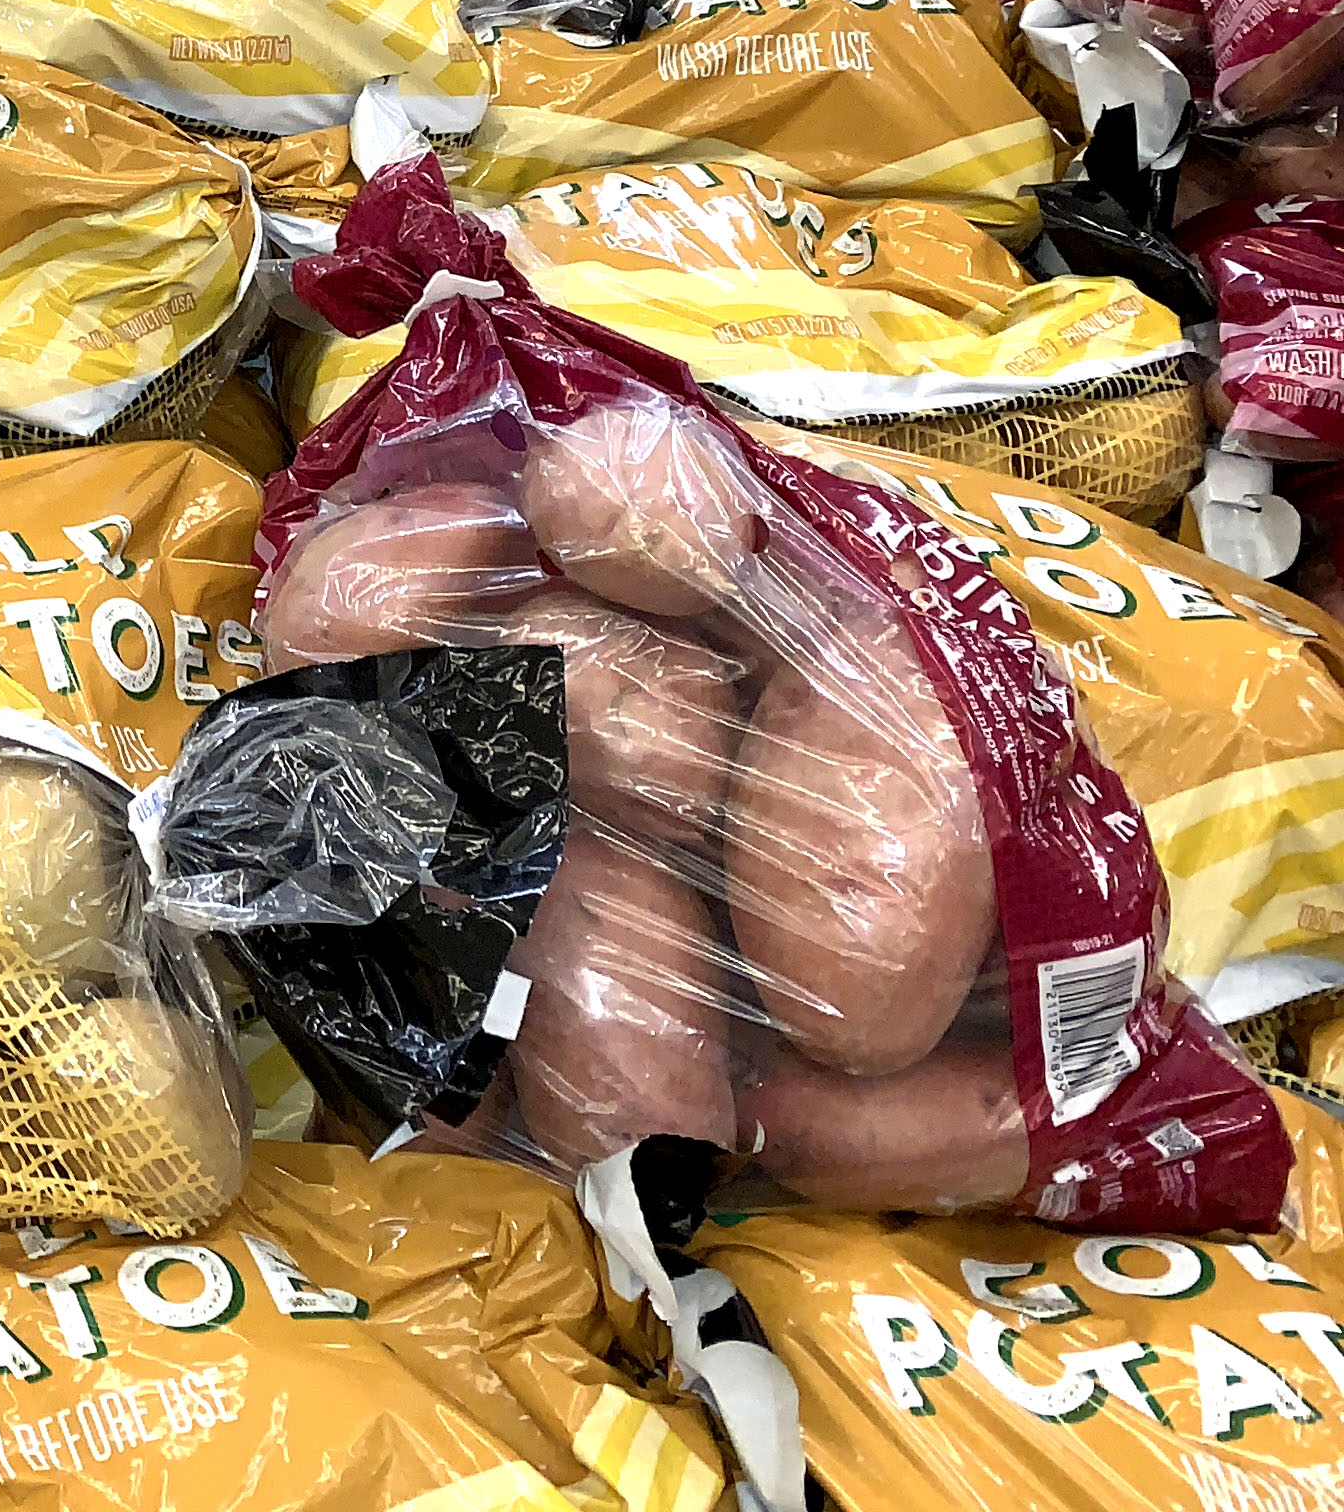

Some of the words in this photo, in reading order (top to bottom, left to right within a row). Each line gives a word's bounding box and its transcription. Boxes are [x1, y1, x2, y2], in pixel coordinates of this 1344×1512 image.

[246, 36, 273, 63] (2.27
[657, 41, 727, 81] WASH
[735, 32, 827, 76] BEFORE
[831, 31, 875, 72] USE
[171, 296, 196, 314] USA
[1265, 348, 1332, 377] WASH
[109, 723, 169, 774] USE
[14, 1380, 164, 1473] BEFORE
[156, 1365, 239, 1435] USE
